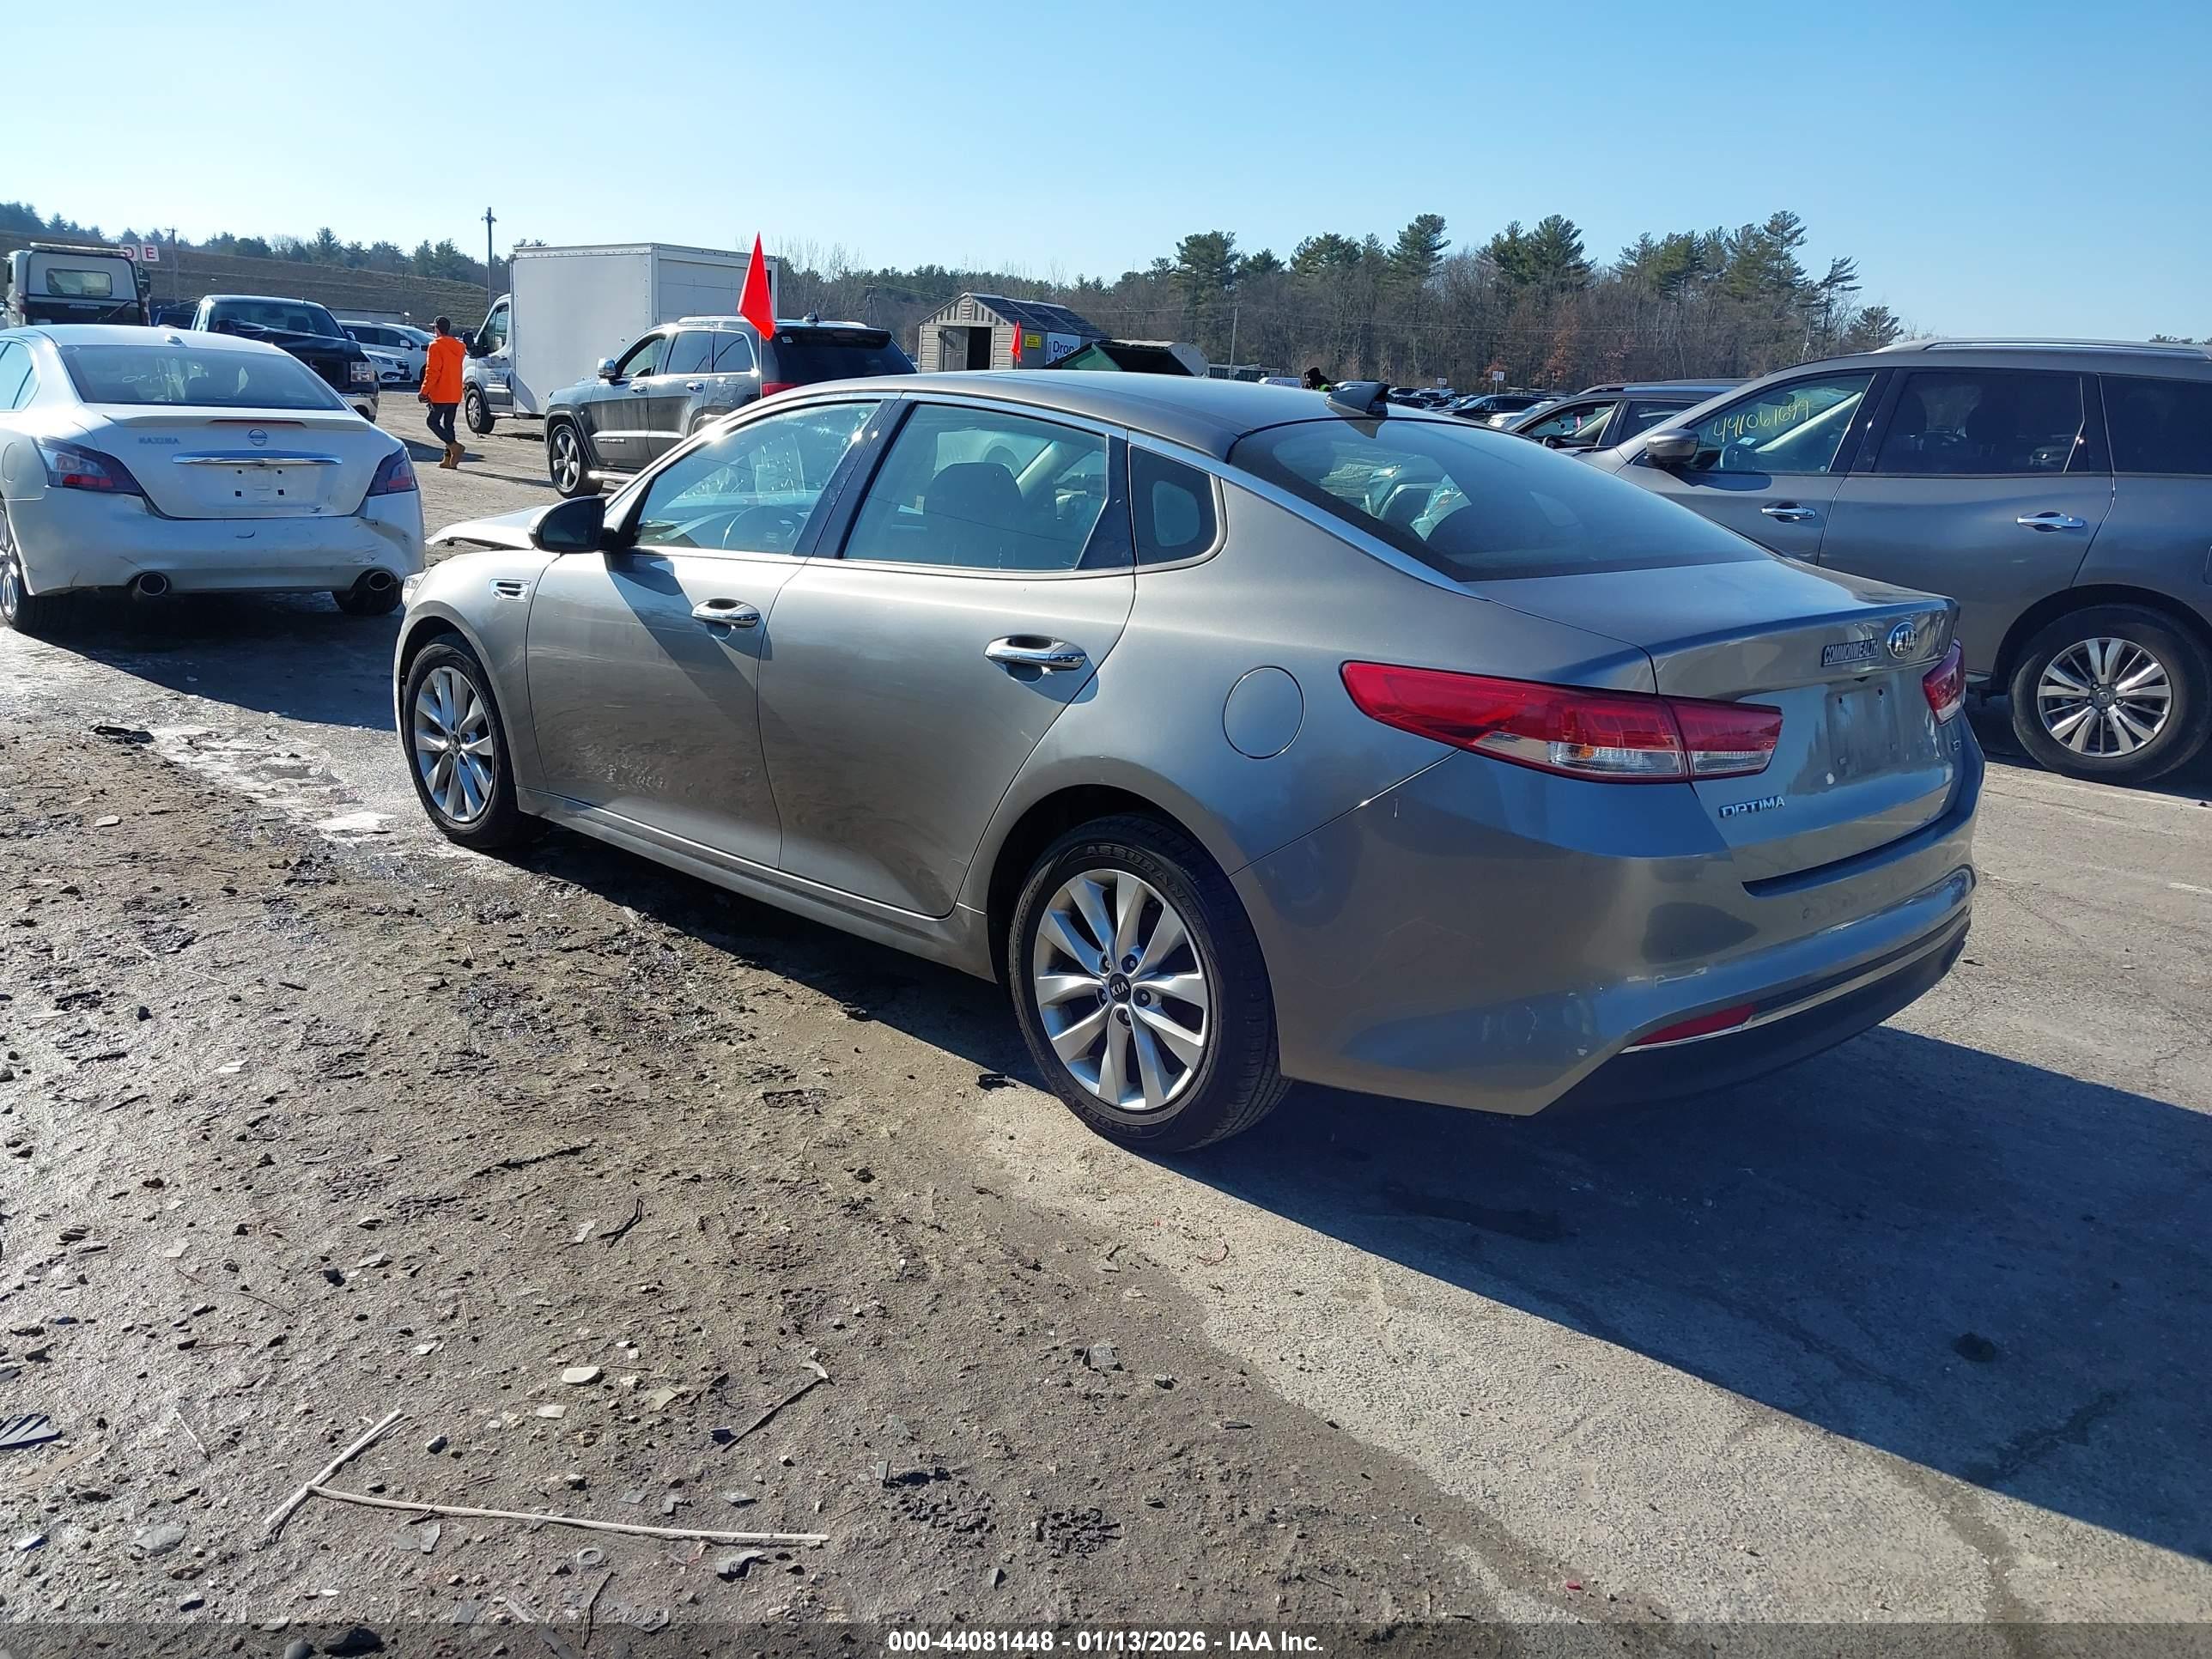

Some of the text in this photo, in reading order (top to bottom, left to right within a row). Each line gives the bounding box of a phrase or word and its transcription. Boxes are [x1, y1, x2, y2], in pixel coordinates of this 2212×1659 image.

[145, 246, 156, 259] E
[1823, 638, 1879, 664] COMMONWEALTH
[1719, 795, 1785, 817] OPTIMA
[1110, 981, 1128, 996] KIA
